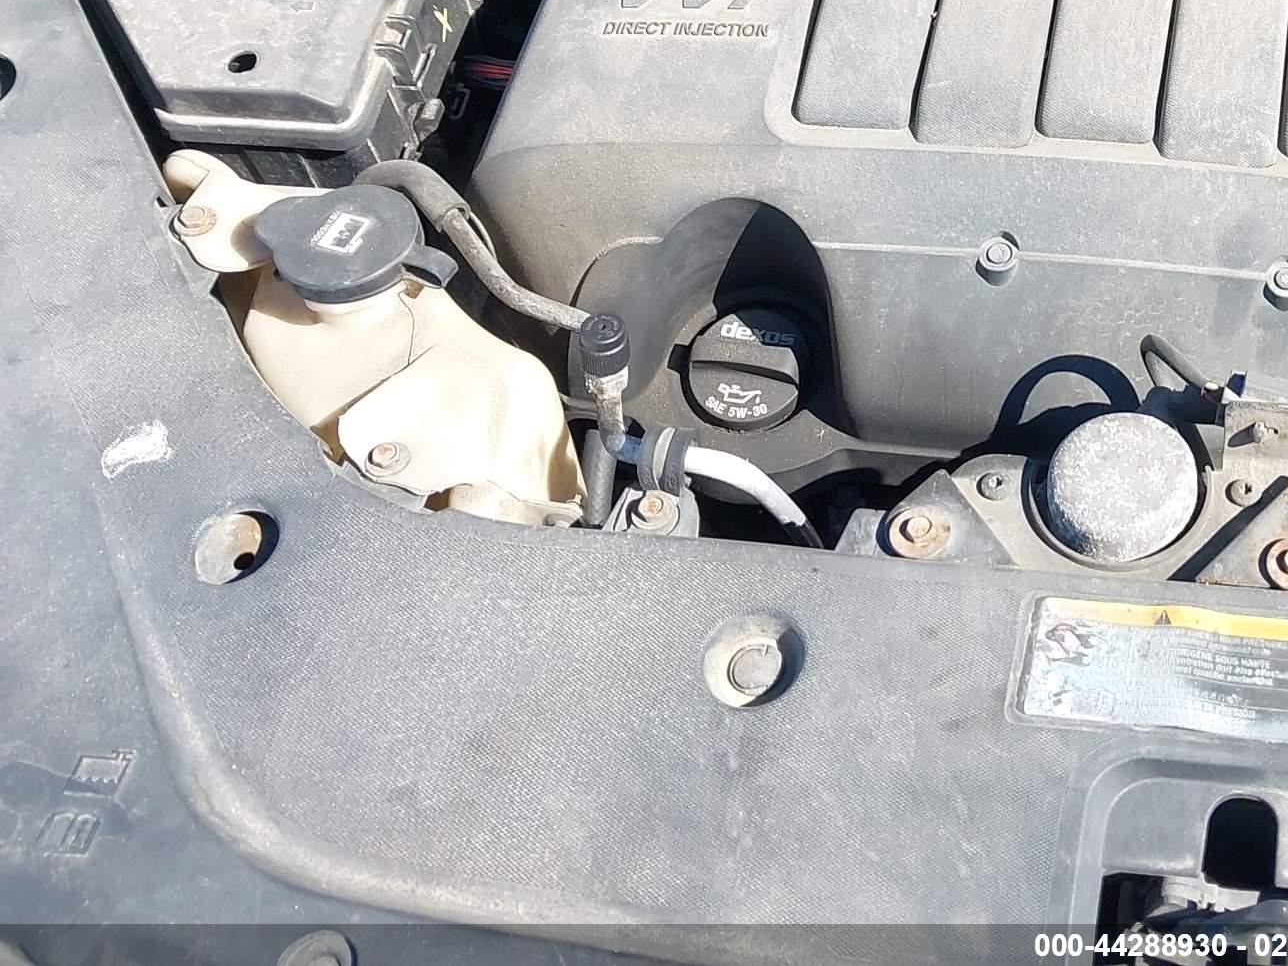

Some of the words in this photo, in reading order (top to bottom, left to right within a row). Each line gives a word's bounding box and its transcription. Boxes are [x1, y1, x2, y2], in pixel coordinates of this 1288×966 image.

[603, 20, 672, 36] DIRECT
[673, 21, 769, 38] INJECTION
[705, 396, 728, 416] SAE
[728, 401, 768, 419] 5W-30
[1215, 655, 1239, 665] SOUS
